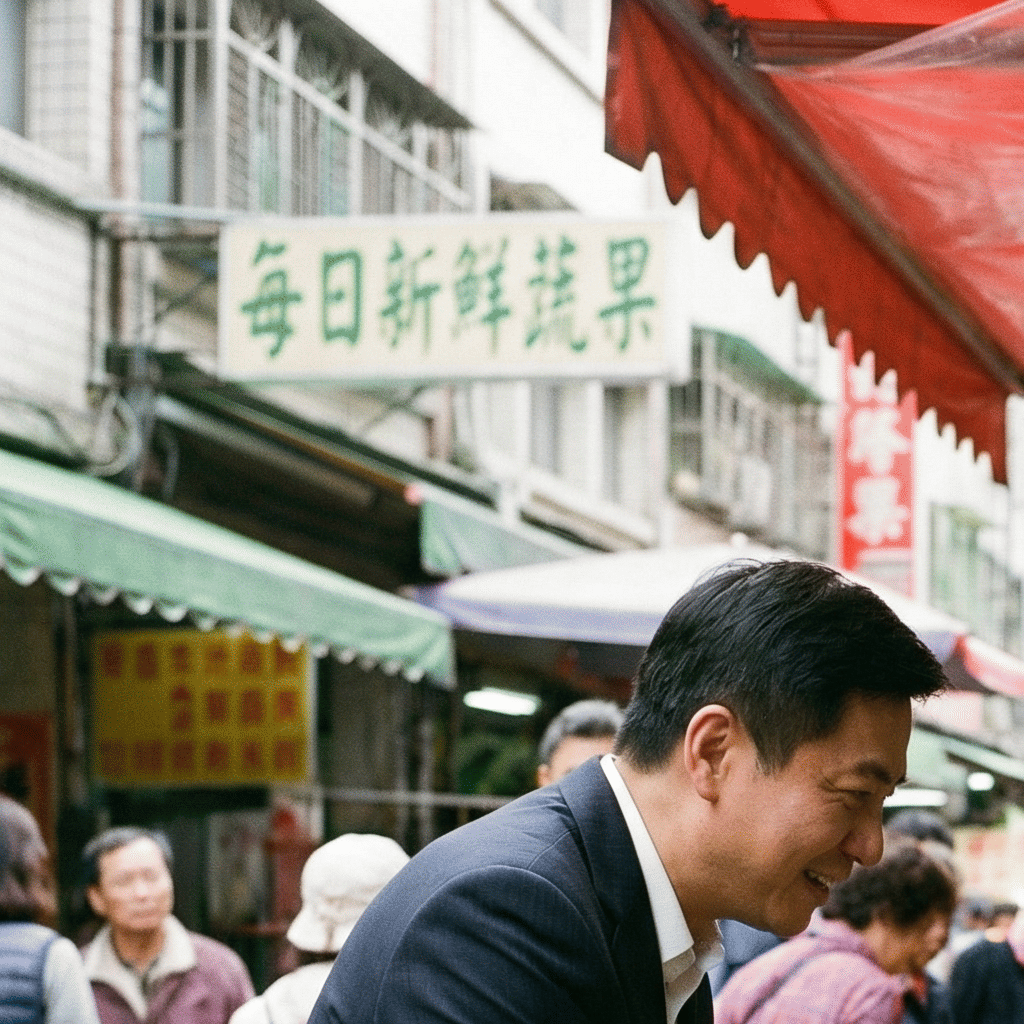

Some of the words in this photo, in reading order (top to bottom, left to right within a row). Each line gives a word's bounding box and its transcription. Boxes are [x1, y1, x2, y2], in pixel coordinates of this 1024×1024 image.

[240, 236, 657, 358] 每日新鮮蔬果
